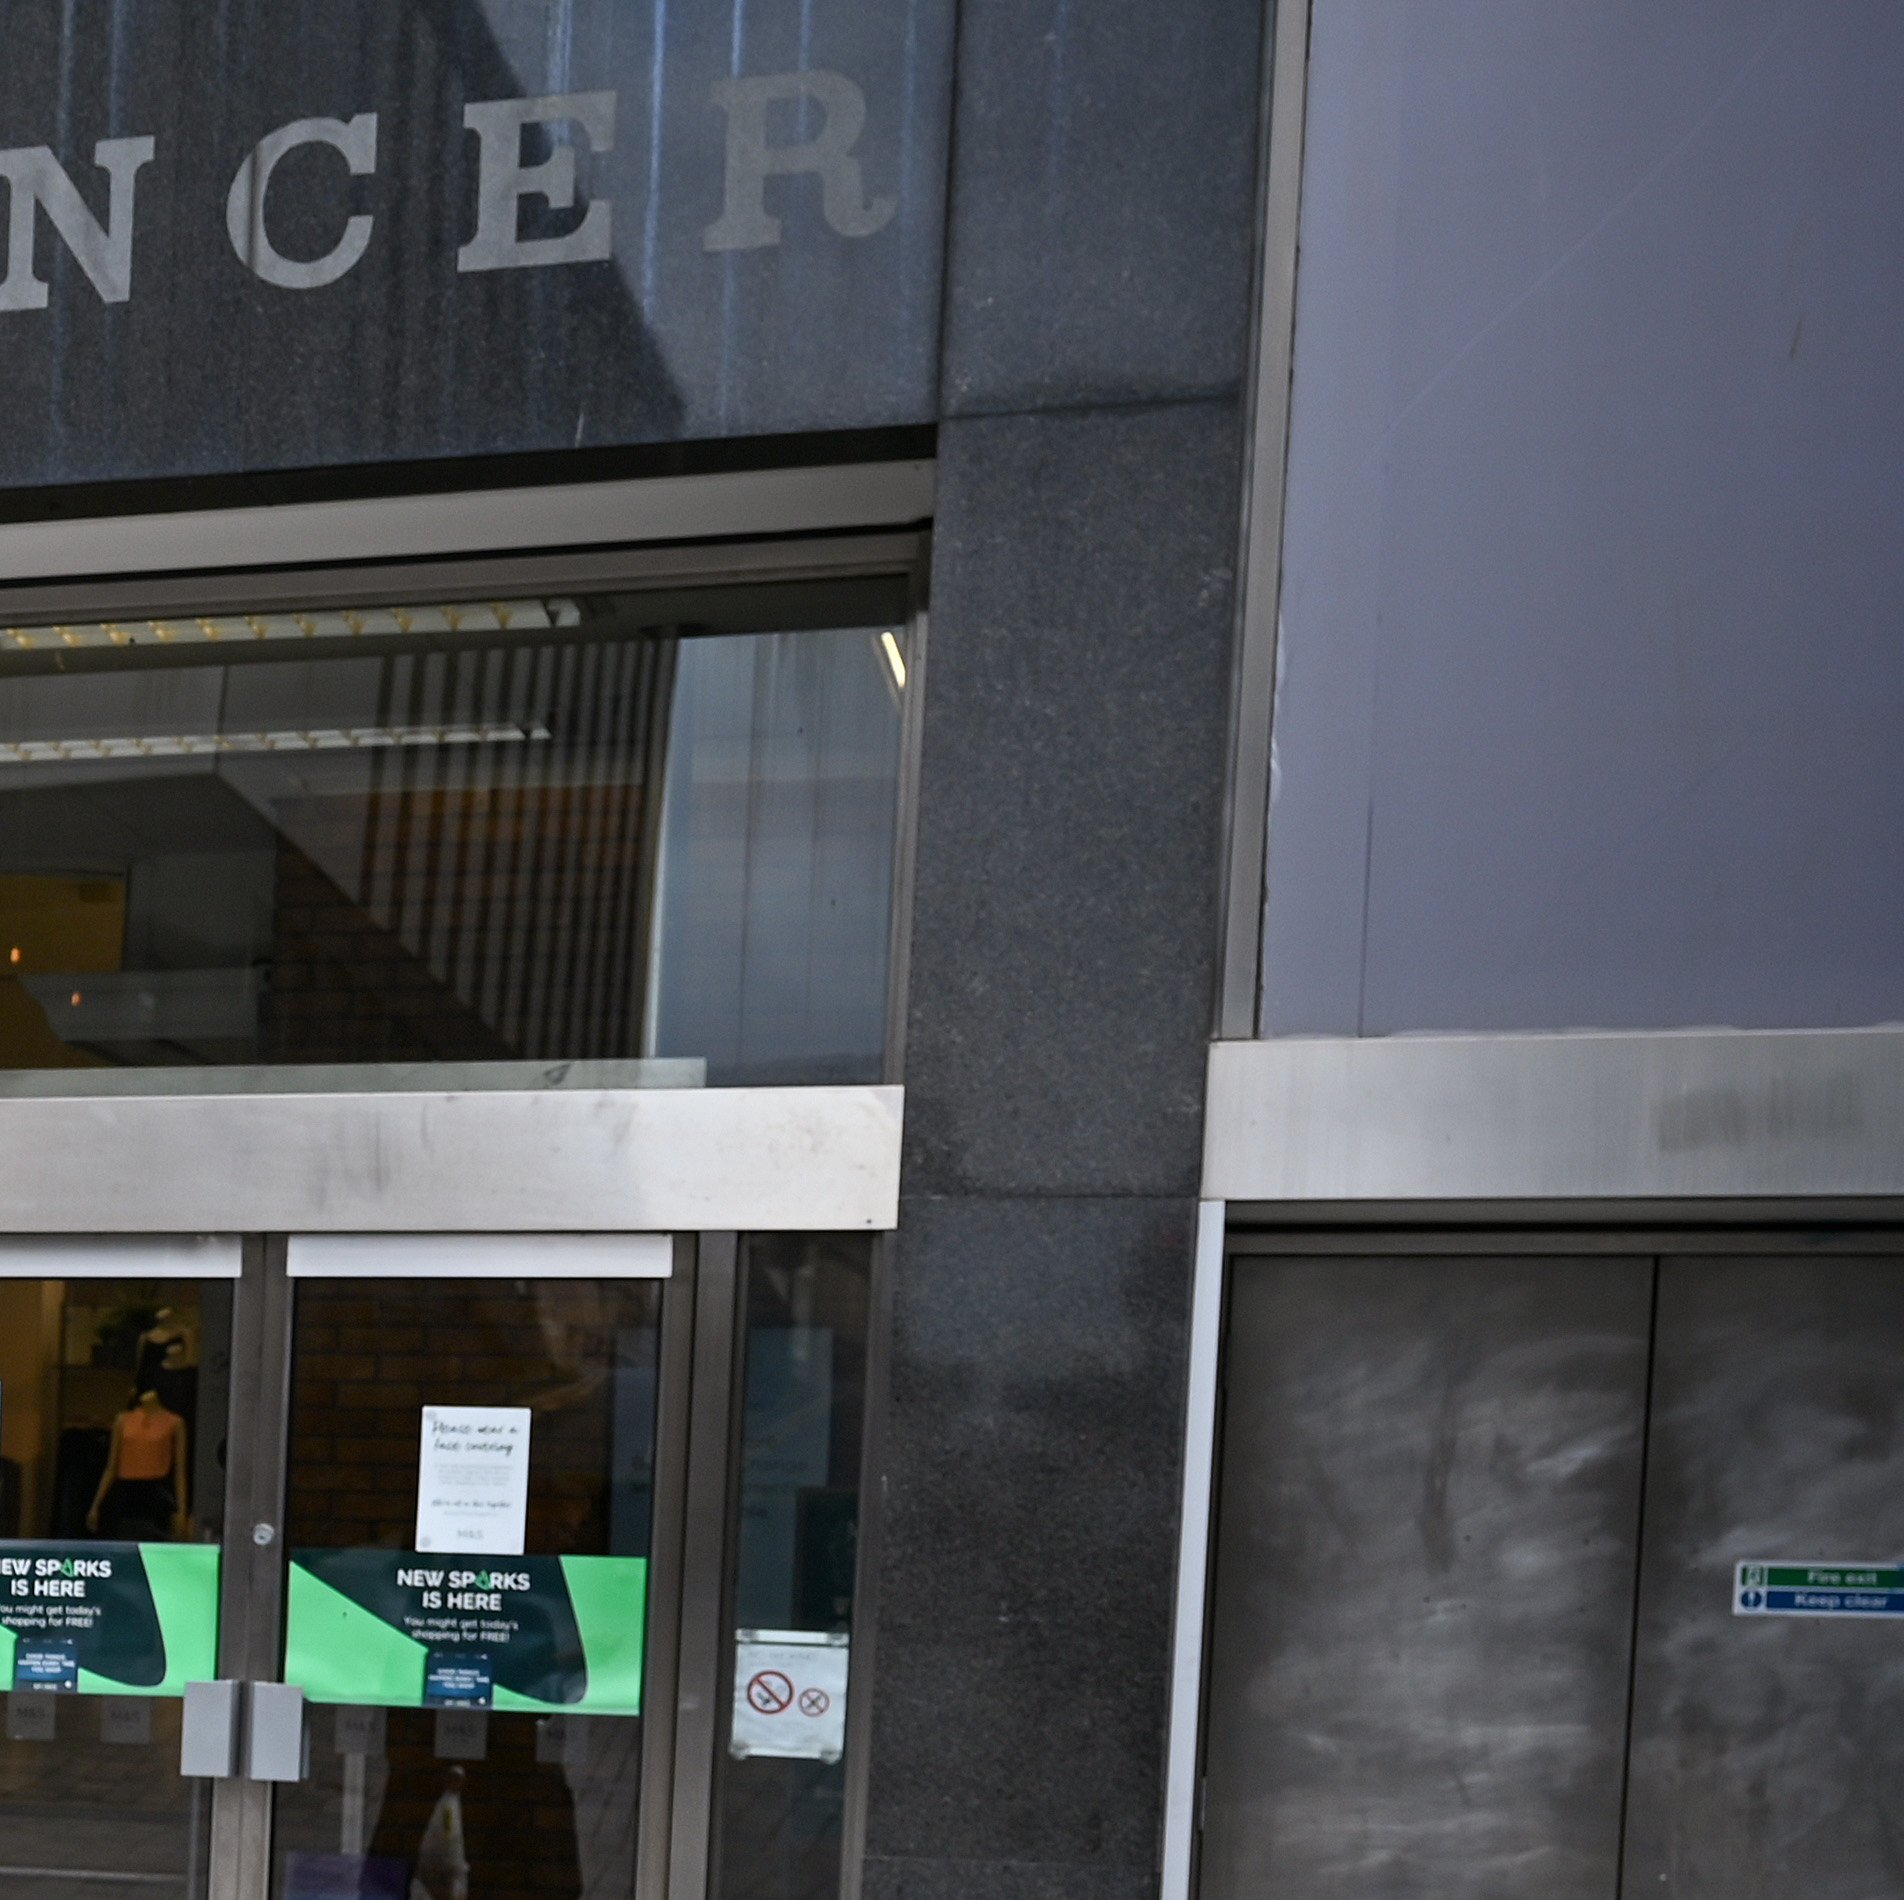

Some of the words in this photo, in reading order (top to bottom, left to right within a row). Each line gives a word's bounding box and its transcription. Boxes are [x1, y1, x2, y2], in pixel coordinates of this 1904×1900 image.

[34, 1557, 113, 1579] SPARKS
[1807, 1568, 1842, 1585] Fire
[1844, 1571, 1878, 1586] exit
[10, 1578, 29, 1596] IS
[33, 1579, 87, 1598] HERE
[396, 1568, 445, 1588] NEW
[447, 1569, 531, 1592] SPARKS
[15, 1604, 44, 1616] might
[45, 1605, 64, 1616] get
[65, 1605, 102, 1617] today's
[422, 1590, 442, 1609] IS
[446, 1591, 503, 1612] HERE
[1793, 1591, 1841, 1611] Keep
[1843, 1592, 1889, 1609] clear
[1, 1616, 46, 1629] shopping
[48, 1617, 64, 1627] for
[403, 1616, 425, 1627] You
[426, 1616, 458, 1629] might
[459, 1618, 478, 1630] get
[411, 1629, 460, 1643] shopping
[461, 1630, 478, 1642] for
